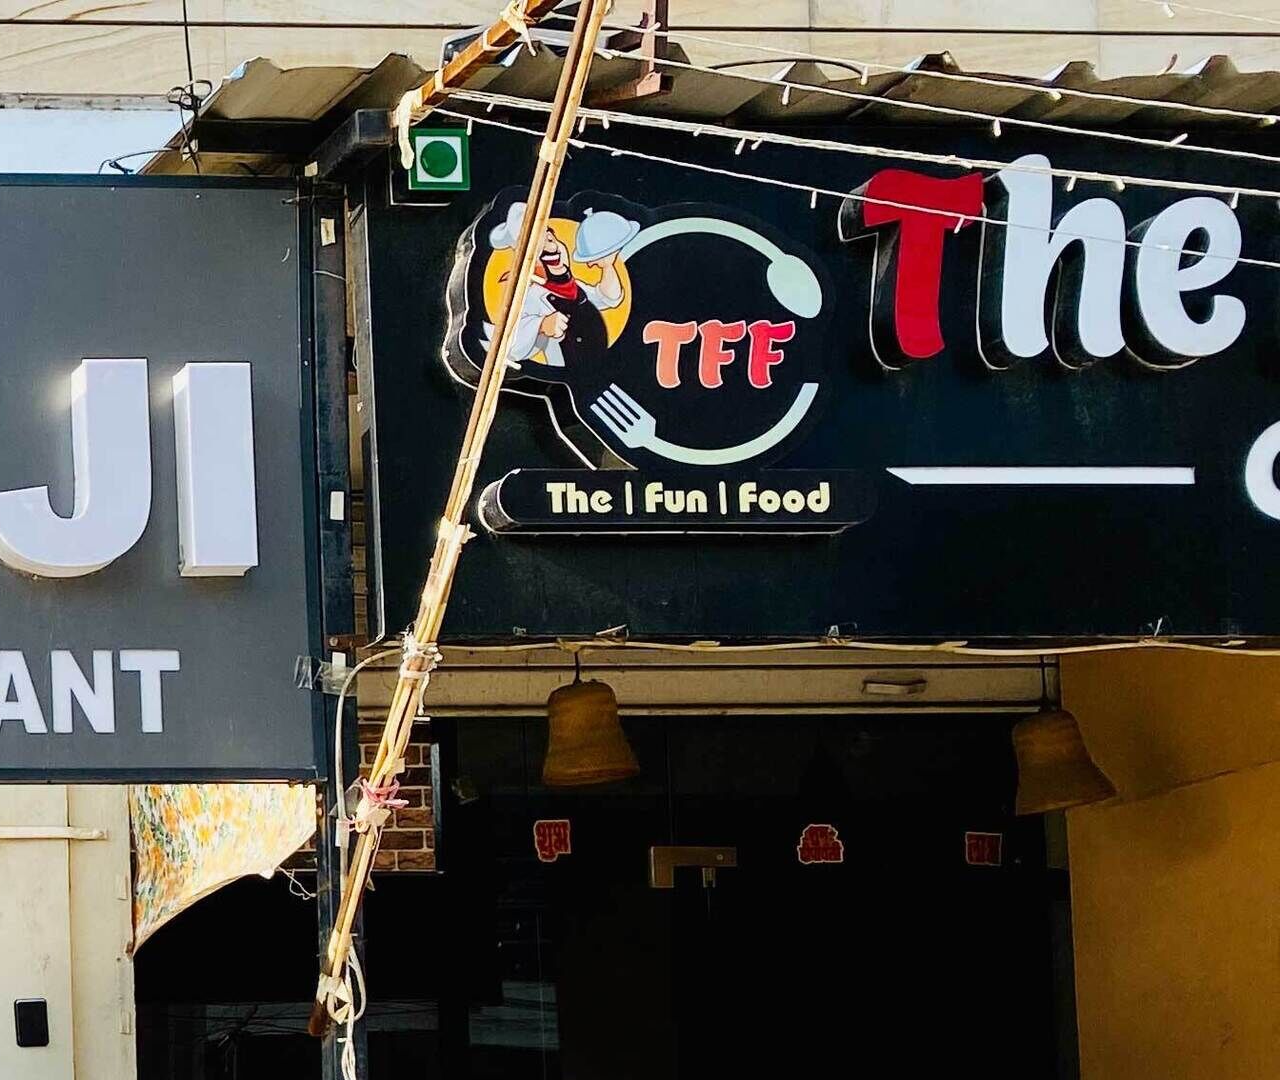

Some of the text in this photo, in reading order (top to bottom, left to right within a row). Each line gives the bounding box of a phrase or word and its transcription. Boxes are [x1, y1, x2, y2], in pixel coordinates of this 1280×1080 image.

[848, 153, 1247, 366] The
[642, 319, 796, 389] TFF
[546, 482, 613, 513] The
